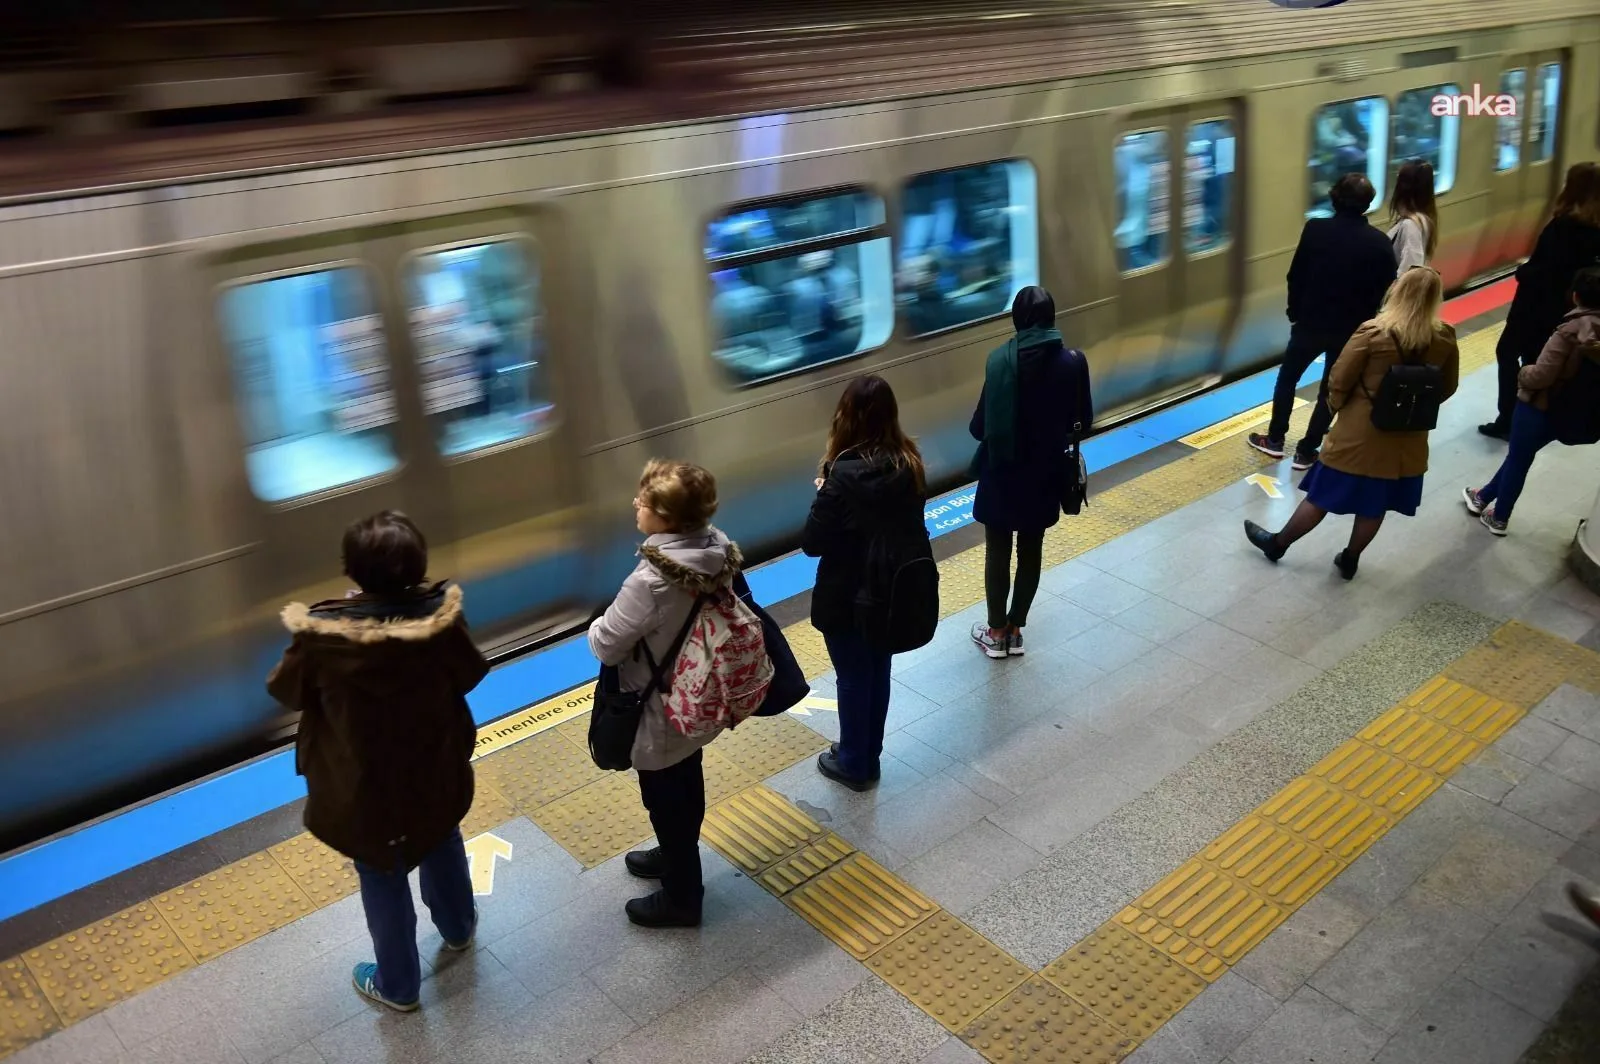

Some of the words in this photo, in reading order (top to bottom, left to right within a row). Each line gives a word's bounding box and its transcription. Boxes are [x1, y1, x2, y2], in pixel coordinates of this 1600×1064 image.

[935, 516, 962, 530] 4-Car
[474, 736, 493, 748] en
[493, 706, 563, 738] inenlere
[566, 692, 595, 708] önc
